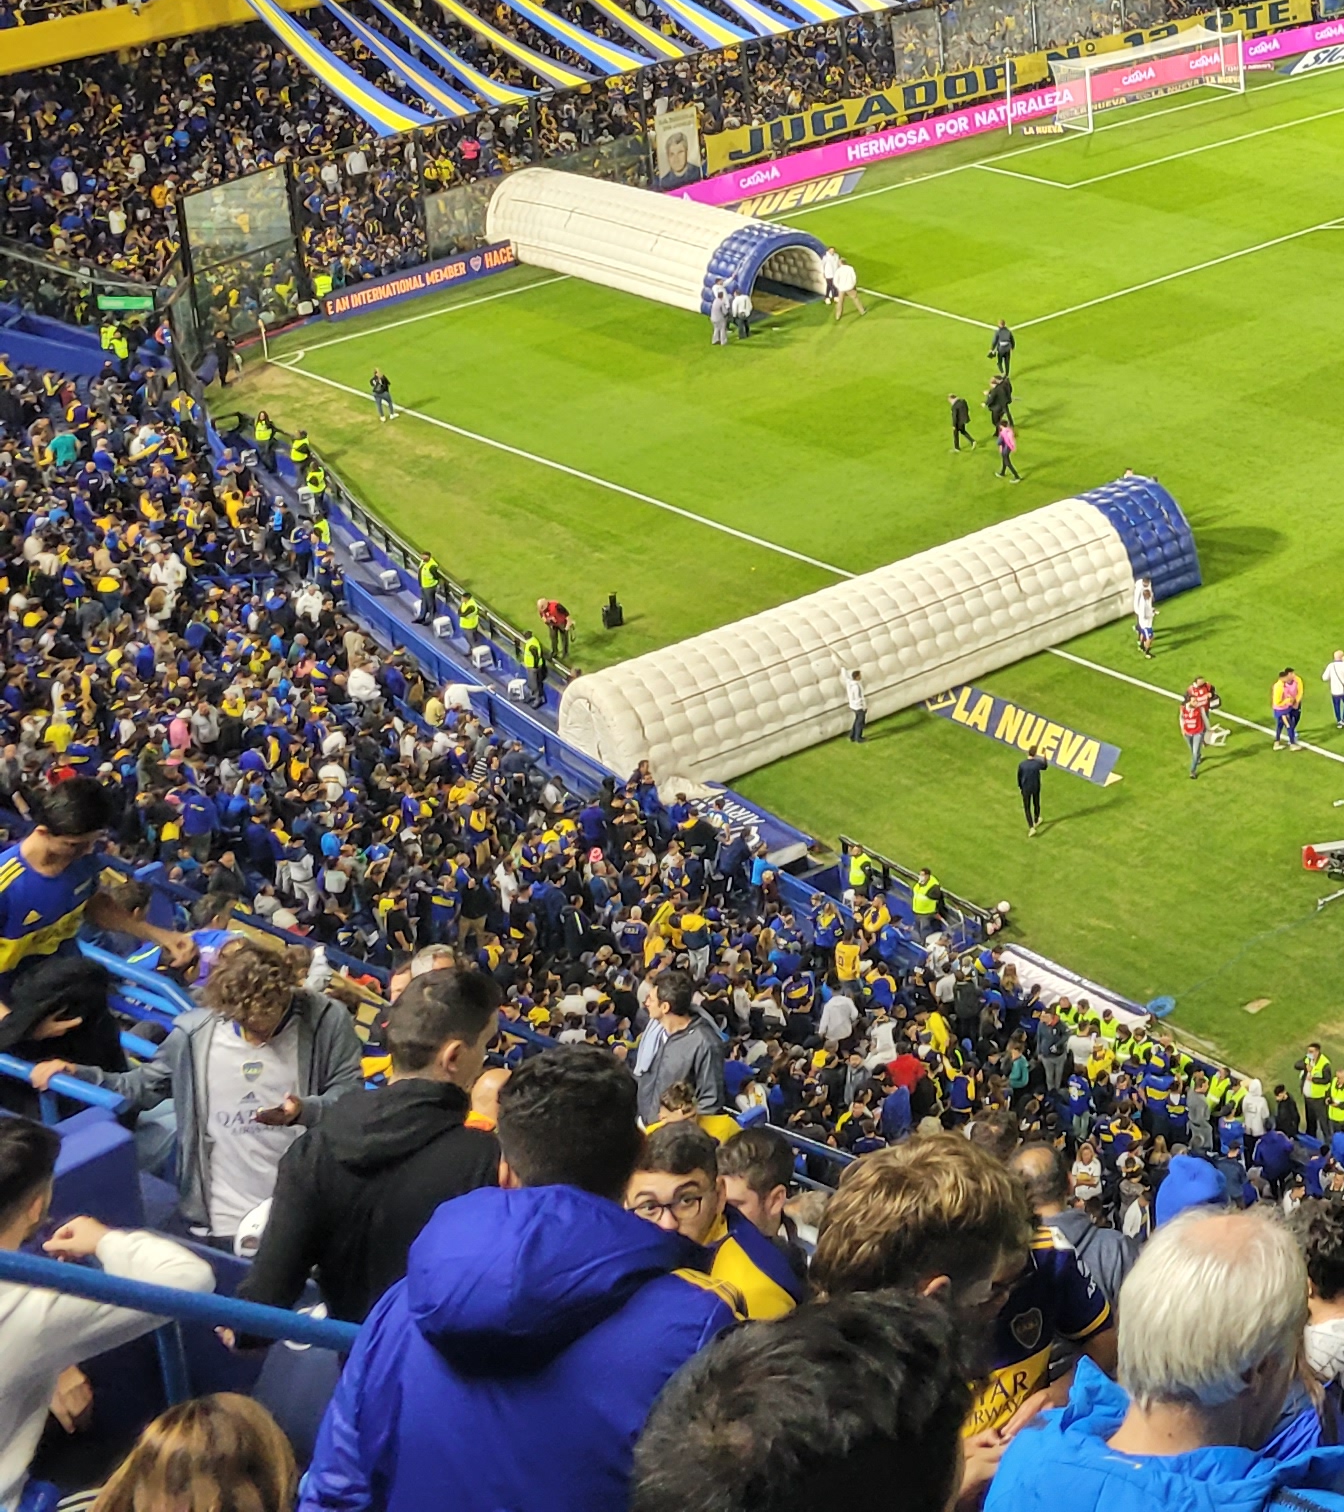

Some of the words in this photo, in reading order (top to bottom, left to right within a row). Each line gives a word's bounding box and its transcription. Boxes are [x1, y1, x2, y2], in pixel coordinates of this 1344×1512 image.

[730, 61, 1018, 162] JUGADOR
[847, 126, 930, 162] HERMOSA
[935, 115, 969, 141] POR
[975, 88, 1074, 129] NATURALEZA
[740, 166, 780, 189] CATAMA
[335, 297, 350, 314] AN
[352, 274, 424, 309] INTERNATIONAL
[426, 262, 466, 284] MEMBER
[484, 246, 513, 269] HACE
[951, 686, 994, 732] LA
[995, 704, 1101, 778] NUEVA
